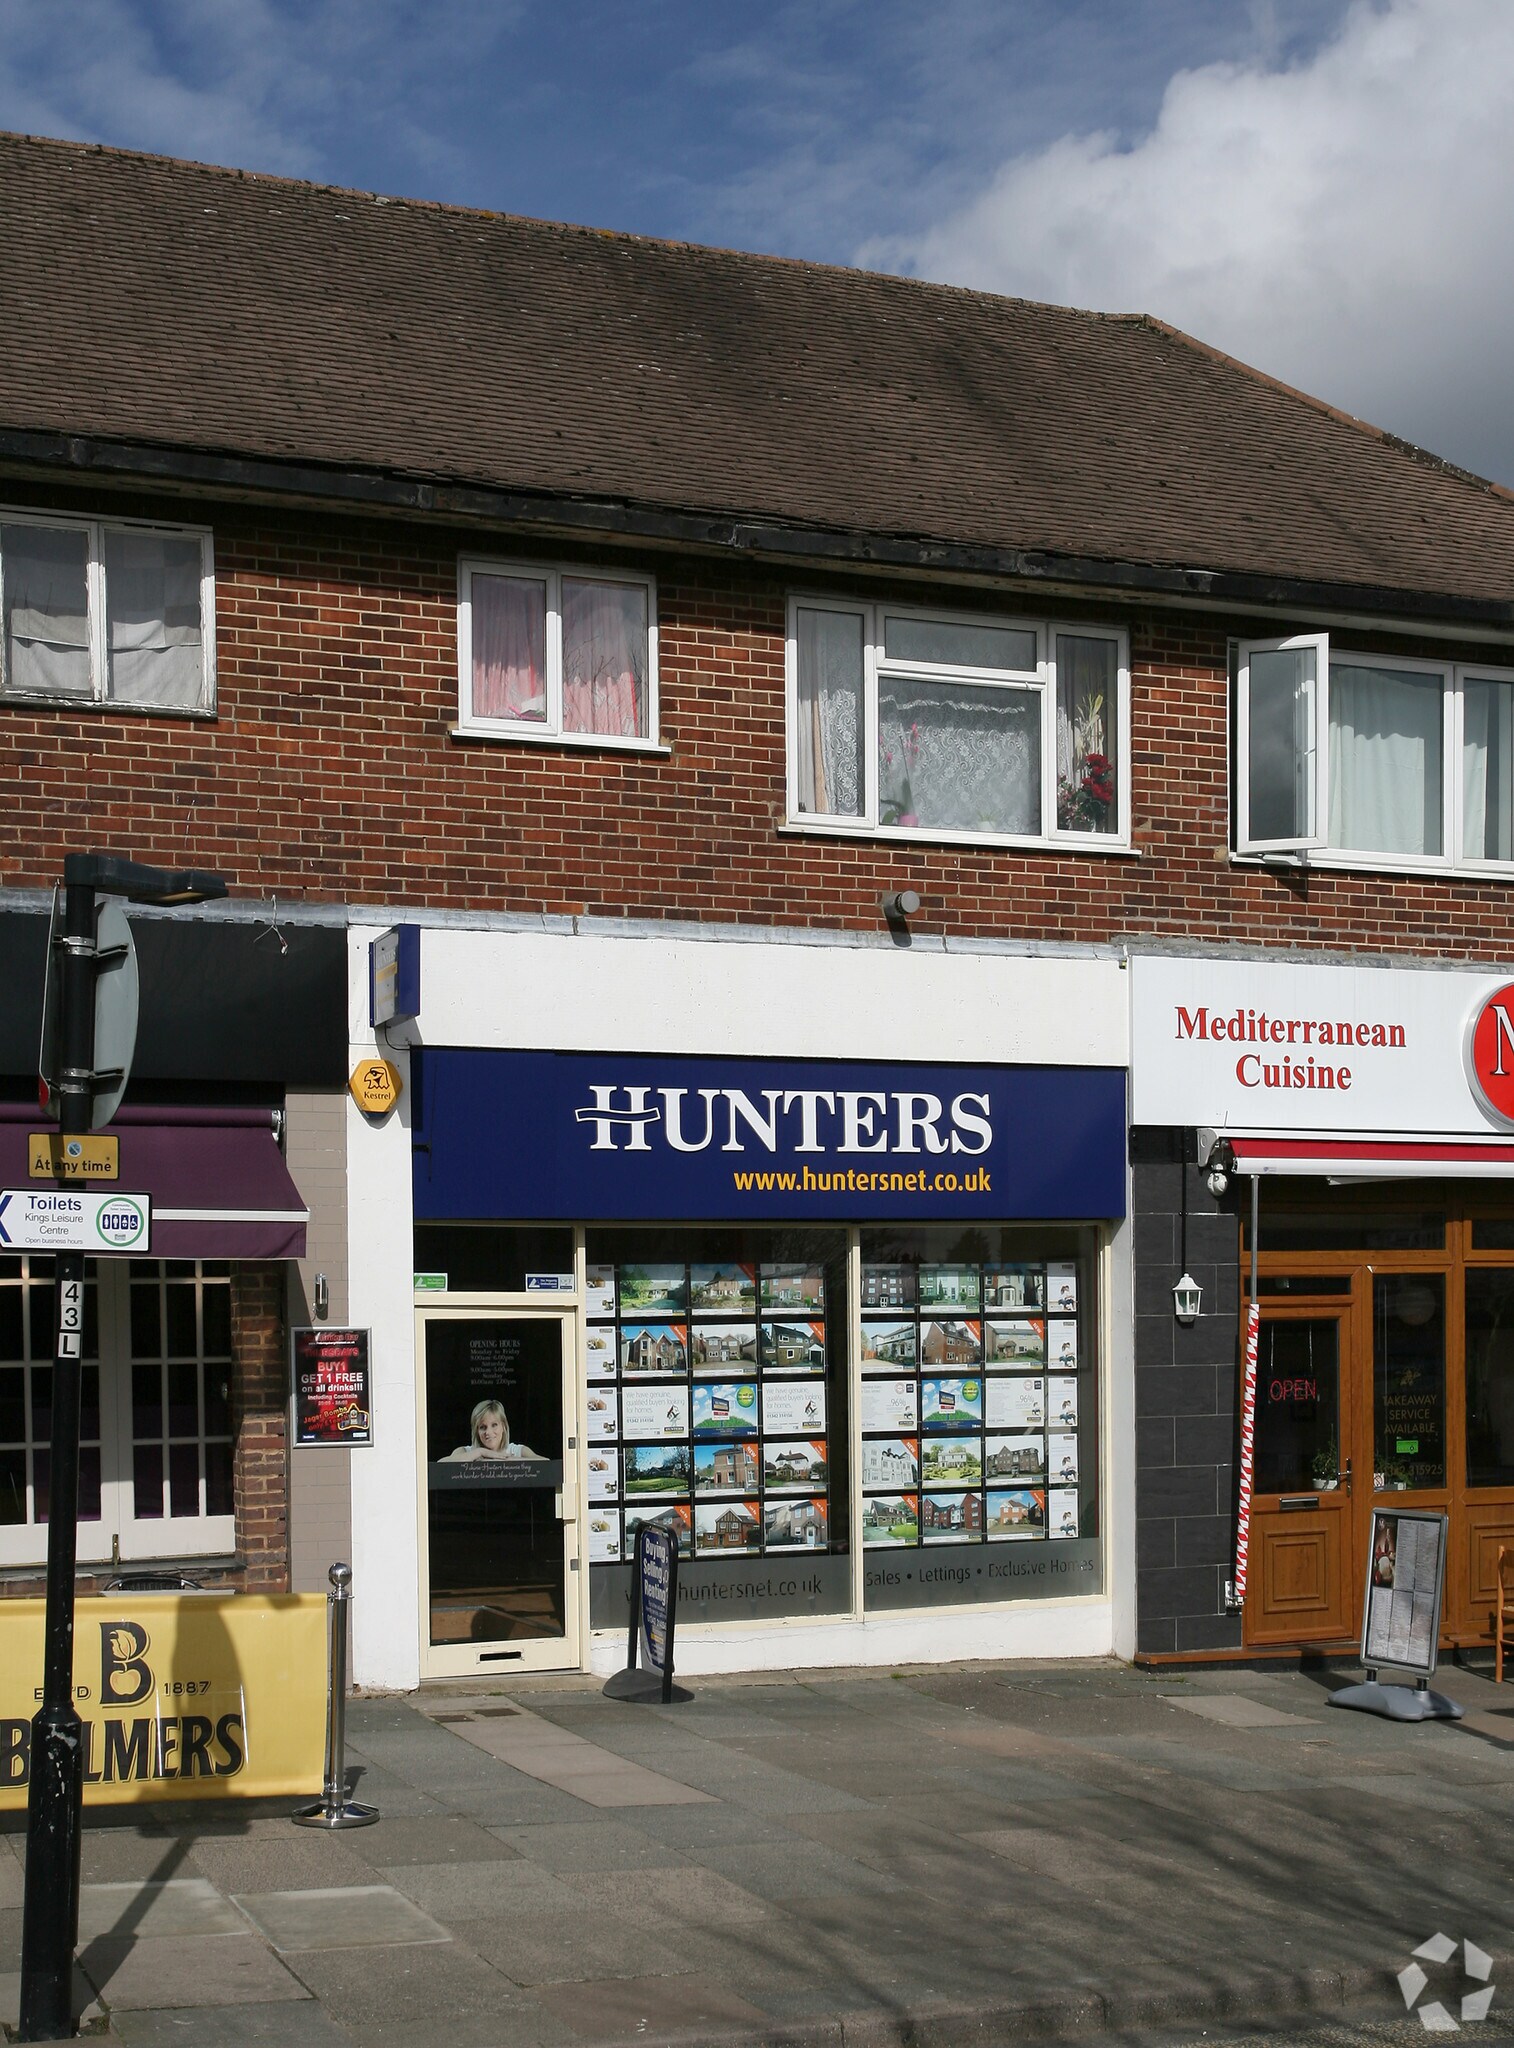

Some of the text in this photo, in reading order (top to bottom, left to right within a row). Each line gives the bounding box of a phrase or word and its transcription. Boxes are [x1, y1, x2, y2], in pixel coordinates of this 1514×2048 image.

[1175, 1006, 1407, 1048] Mediterranean
[1235, 1054, 1353, 1091] Cuisine
[363, 1091, 391, 1101] Kestrel
[576, 1085, 993, 1154] HUNTERS
[35, 1159, 112, 1173] At any time
[733, 1165, 993, 1192] www.huntersnet.co.uk
[27, 1195, 82, 1211] Toilets
[24, 1212, 84, 1224] Kings Leisure
[39, 1225, 69, 1235] Centre
[499, 1340, 520, 1348] HOURS
[301, 1372, 363, 1384] GET 1 FREE
[315, 1384, 326, 1393] all
[327, 1382, 363, 1392] drinks!!!
[1270, 1379, 1316, 1401] OPEN
[635, 1391, 649, 1399] have
[1383, 1395, 1437, 1406] TAKEAWAY
[1389, 1408, 1430, 1421] SERVICE
[1384, 1423, 1436, 1434] AVAILABLE
[747, 1445, 757, 1458] NEW
[906, 1441, 916, 1454] NEW
[906, 1497, 916, 1510] SOLD
[866, 1570, 901, 1586] Sales
[919, 1566, 971, 1584] Lettings
[988, 1560, 1046, 1578] Exclusive
[164, 1681, 211, 1696] 1887
[0, 1713, 245, 1788] BLMERS
